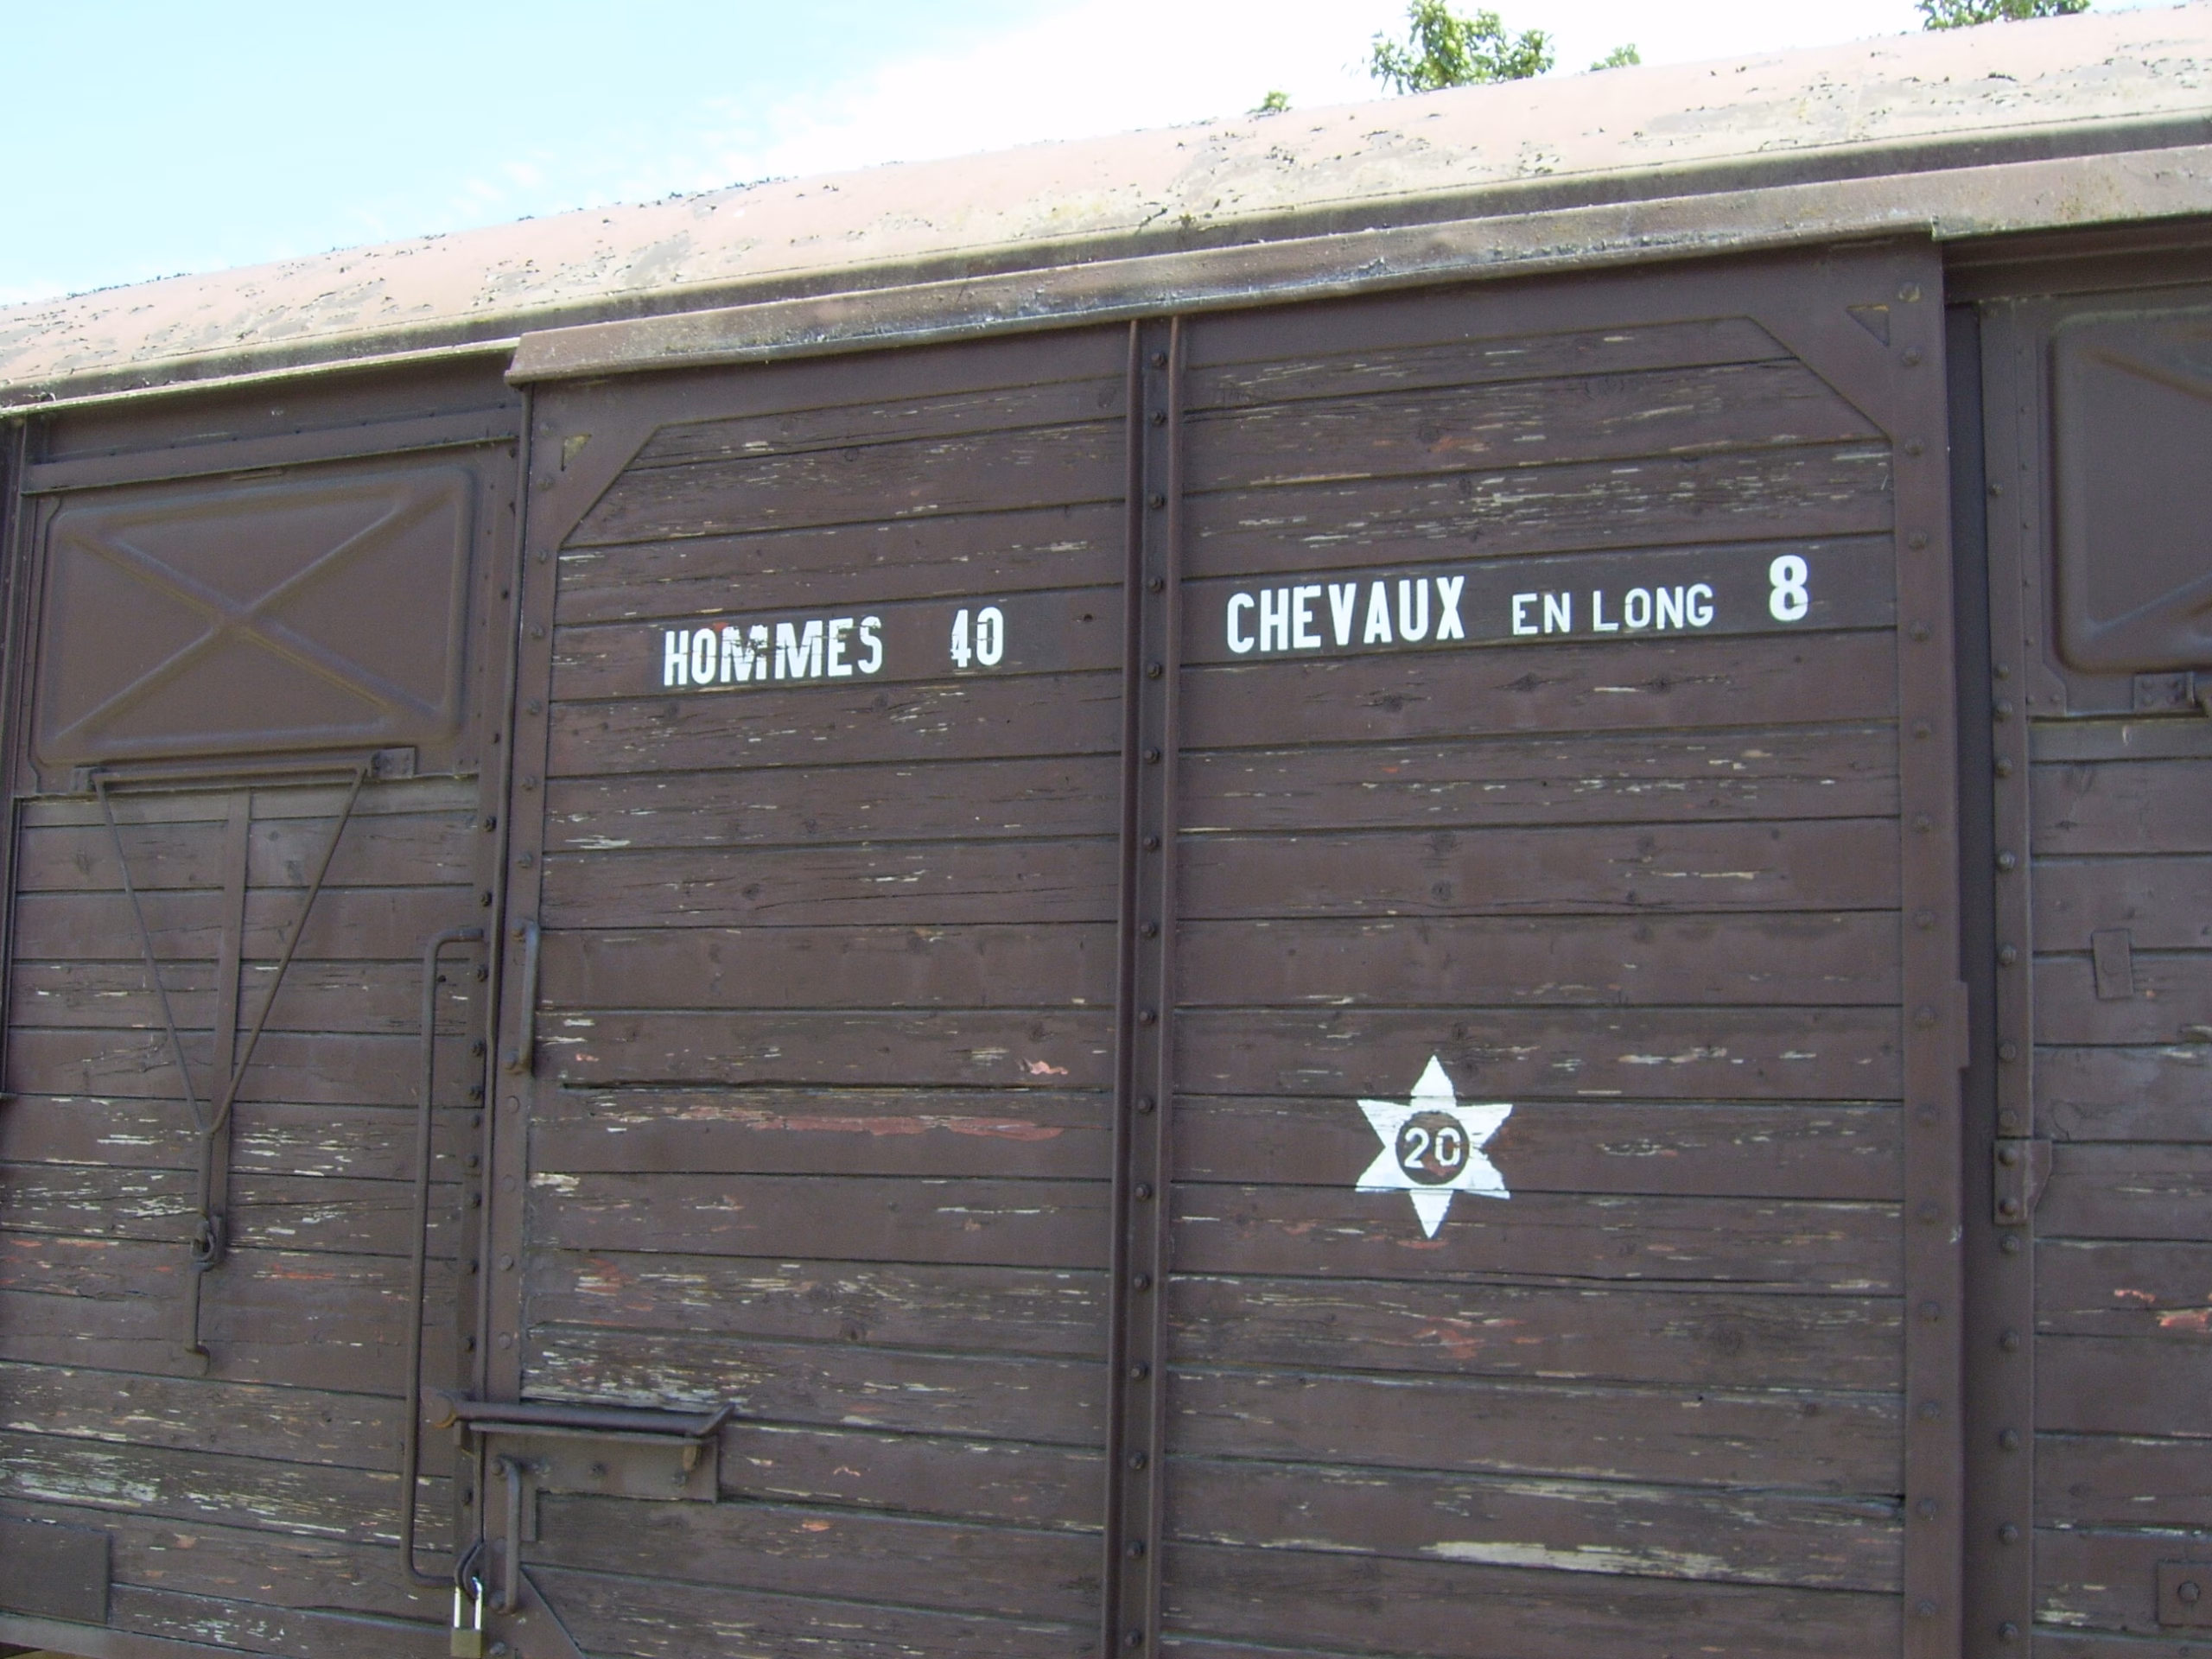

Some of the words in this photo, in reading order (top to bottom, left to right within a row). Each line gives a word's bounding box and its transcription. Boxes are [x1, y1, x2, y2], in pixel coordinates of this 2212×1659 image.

[1227, 575, 1465, 655] CHEVAUX
[1512, 592, 1572, 636] EN
[1592, 583, 1714, 632] LONG
[1769, 555, 1809, 622] 8
[663, 615, 884, 687] HOMMES
[950, 607, 1005, 669] 40
[1403, 1126, 1462, 1169] 20
